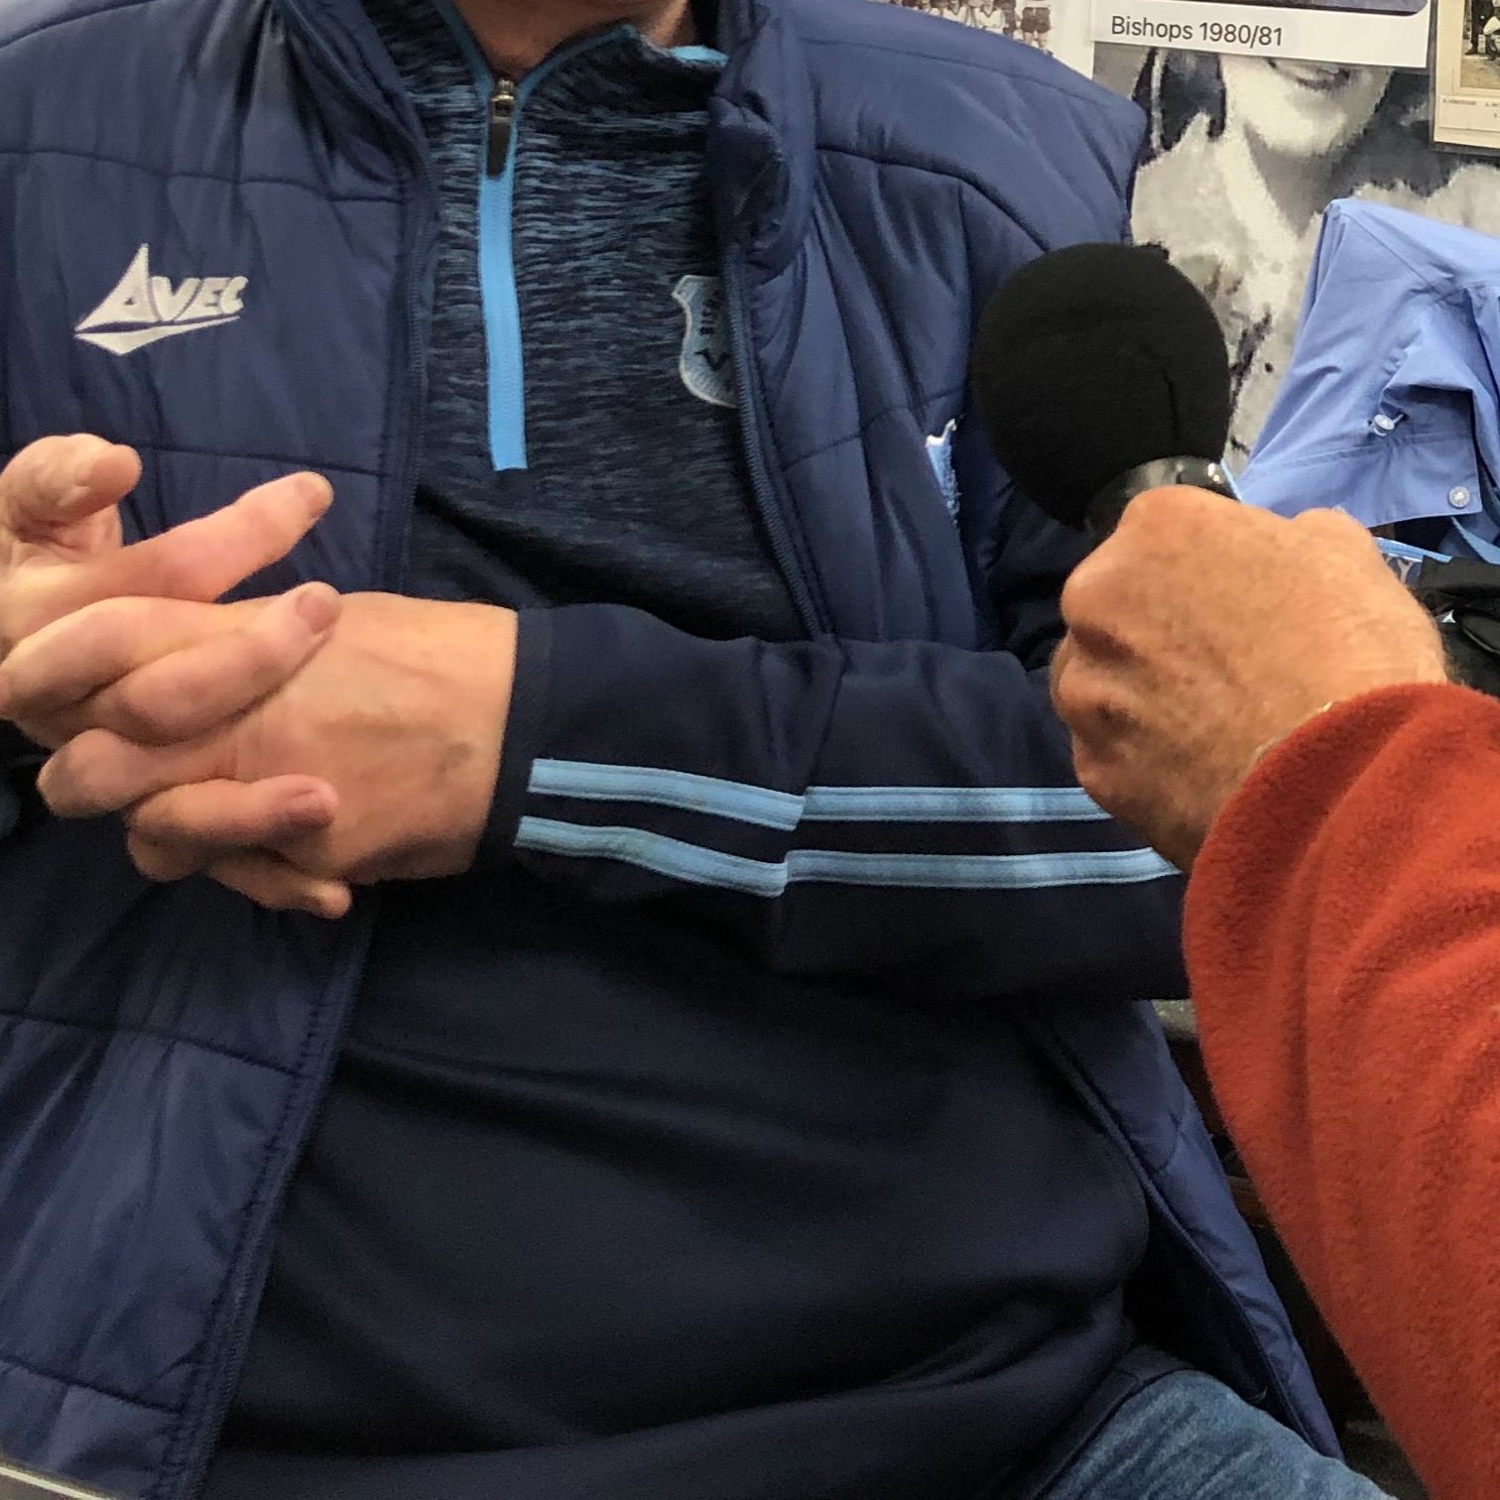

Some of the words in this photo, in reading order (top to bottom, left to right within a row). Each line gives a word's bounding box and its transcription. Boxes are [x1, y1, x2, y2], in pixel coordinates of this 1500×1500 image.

[1112, 15, 1194, 43] Bishops
[1199, 22, 1283, 49] 1980/81
[74, 243, 249, 332] AVEC
